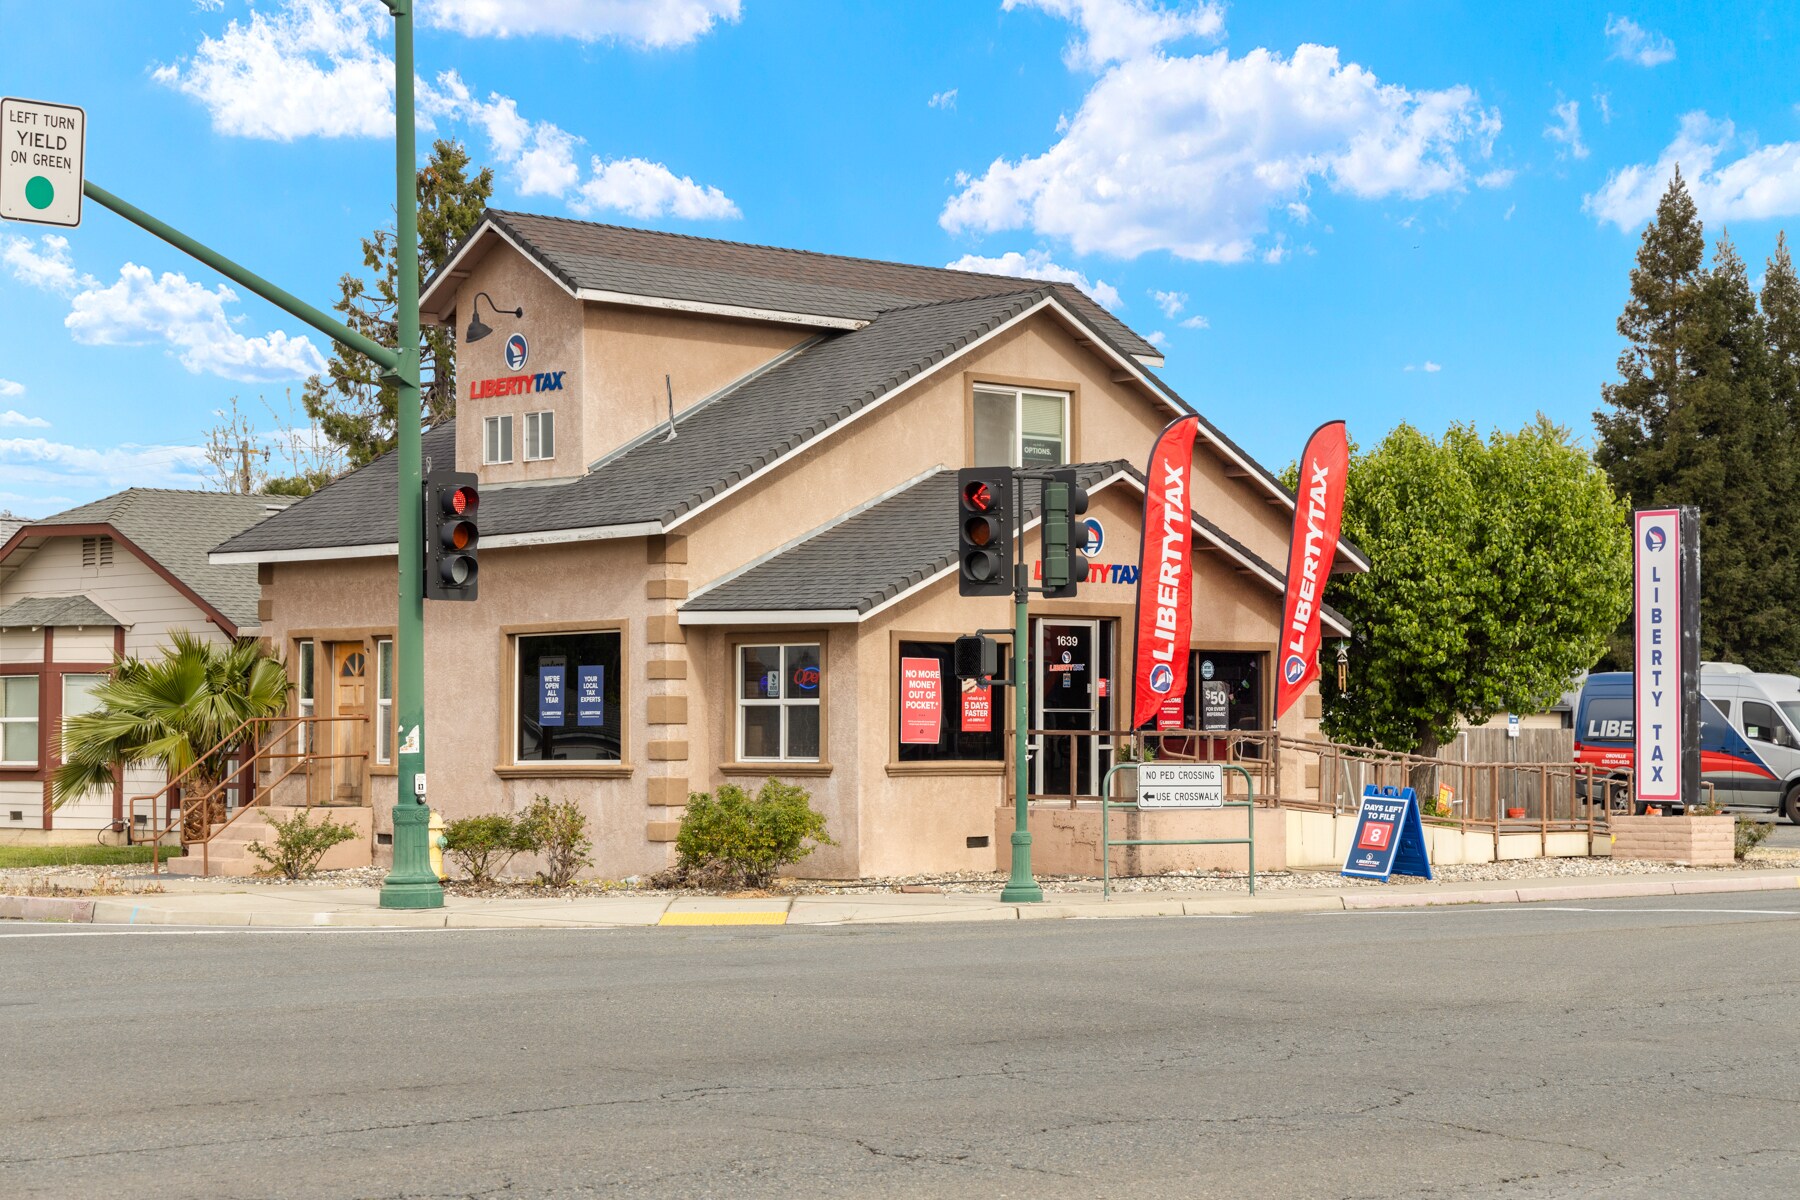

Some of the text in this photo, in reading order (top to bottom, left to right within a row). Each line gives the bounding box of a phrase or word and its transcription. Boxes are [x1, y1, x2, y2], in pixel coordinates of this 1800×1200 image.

[10, 110, 75, 130] LEFT TURN
[17, 130, 67, 151] YIELD
[11, 150, 71, 169] ON GREEN
[1024, 446, 1052, 456] OPTIONS.
[1056, 635, 1078, 647] 1639
[905, 669, 940, 679] NO MORE
[1651, 566, 1664, 782] LIBERTY TAX
[909, 680, 936, 689] MONEY
[908, 690, 936, 699] OUT OF
[1205, 690, 1226, 705] $50
[964, 701, 989, 710] 5 DAYS
[965, 710, 989, 718] FASTER
[1146, 771, 1215, 780] NO PED CROSSING
[1156, 792, 1219, 801] USE CROSSWALK
[1364, 803, 1403, 814] DAYS LEFT
[1370, 829, 1382, 842] 8
